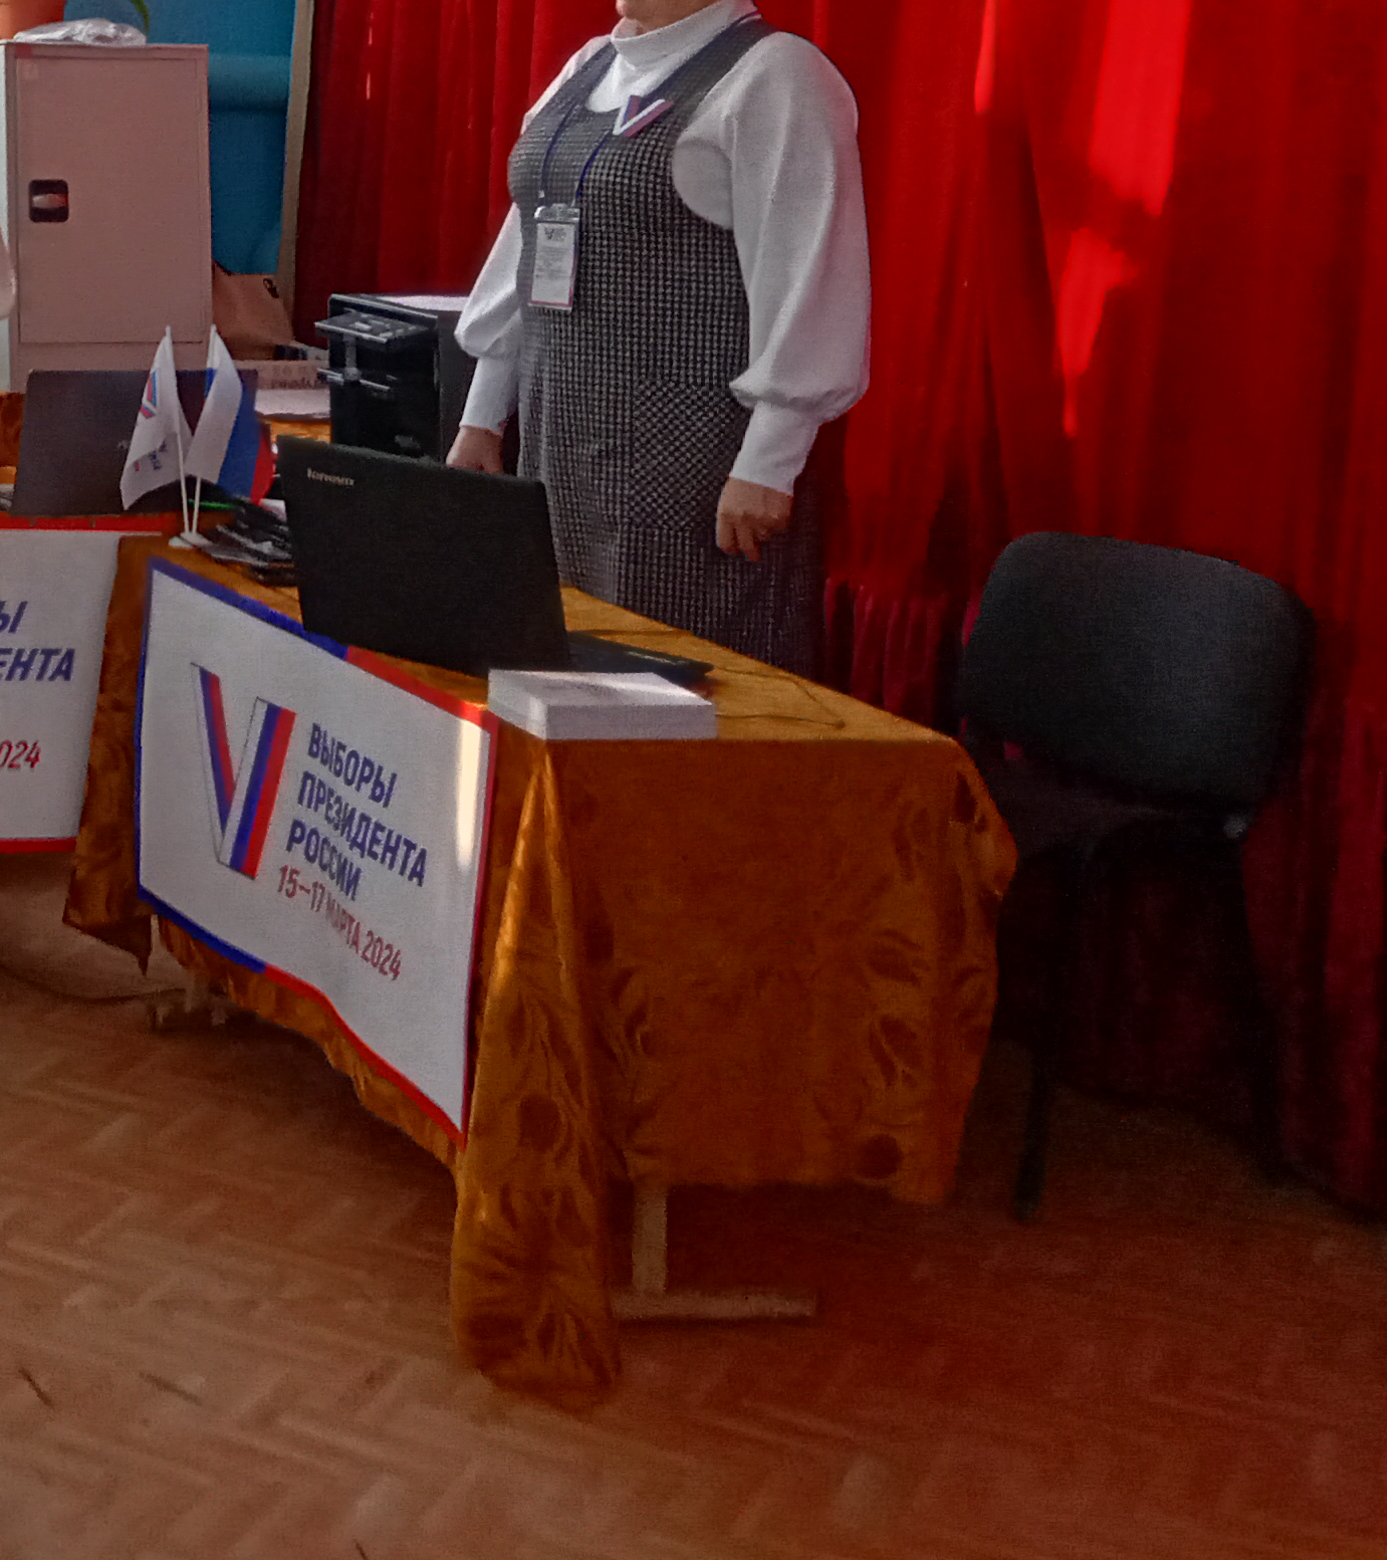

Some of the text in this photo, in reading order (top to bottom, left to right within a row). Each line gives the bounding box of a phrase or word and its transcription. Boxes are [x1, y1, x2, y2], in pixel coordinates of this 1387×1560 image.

[308, 722, 397, 809] ВЫБОРЫ
[286, 818, 363, 902] РОССИИ
[296, 770, 427, 888] ПРЕЗИДЕНТА
[326, 896, 362, 956] МАРТА
[361, 929, 402, 982] 2024
